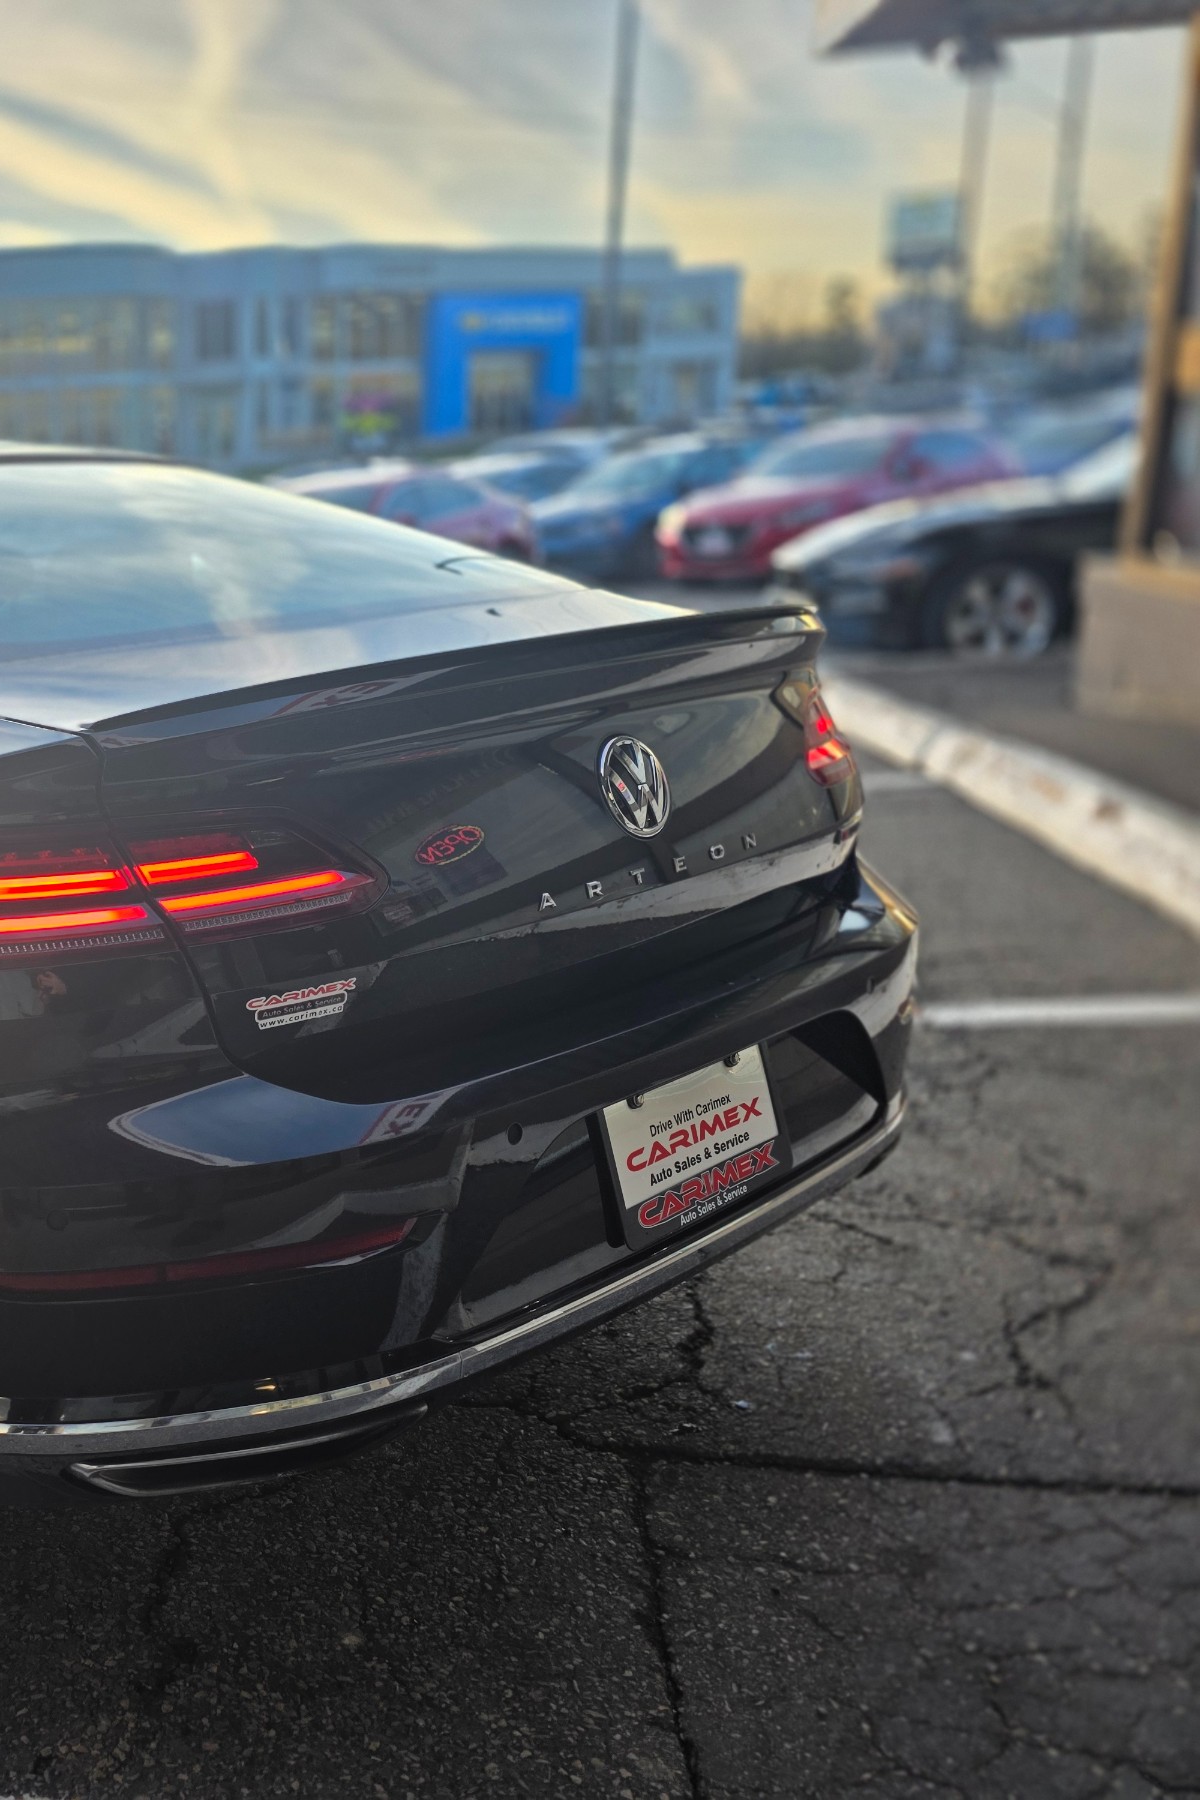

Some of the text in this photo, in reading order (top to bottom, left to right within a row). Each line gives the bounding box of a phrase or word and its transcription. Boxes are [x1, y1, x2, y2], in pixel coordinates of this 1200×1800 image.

[538, 833, 757, 911] ARTEON
[247, 979, 356, 1009] CARIMEX
[263, 1009, 282, 1018] Auto
[284, 1003, 304, 1013] Sales
[315, 997, 341, 1007] Service
[626, 1096, 762, 1172] CARIMEX
[649, 1094, 732, 1138] Drive With Carimex
[650, 1131, 750, 1186] Auto Sales & Service
[639, 1142, 778, 1228] CARIMEX
[680, 1185, 748, 1226] Auto Sales & Service
